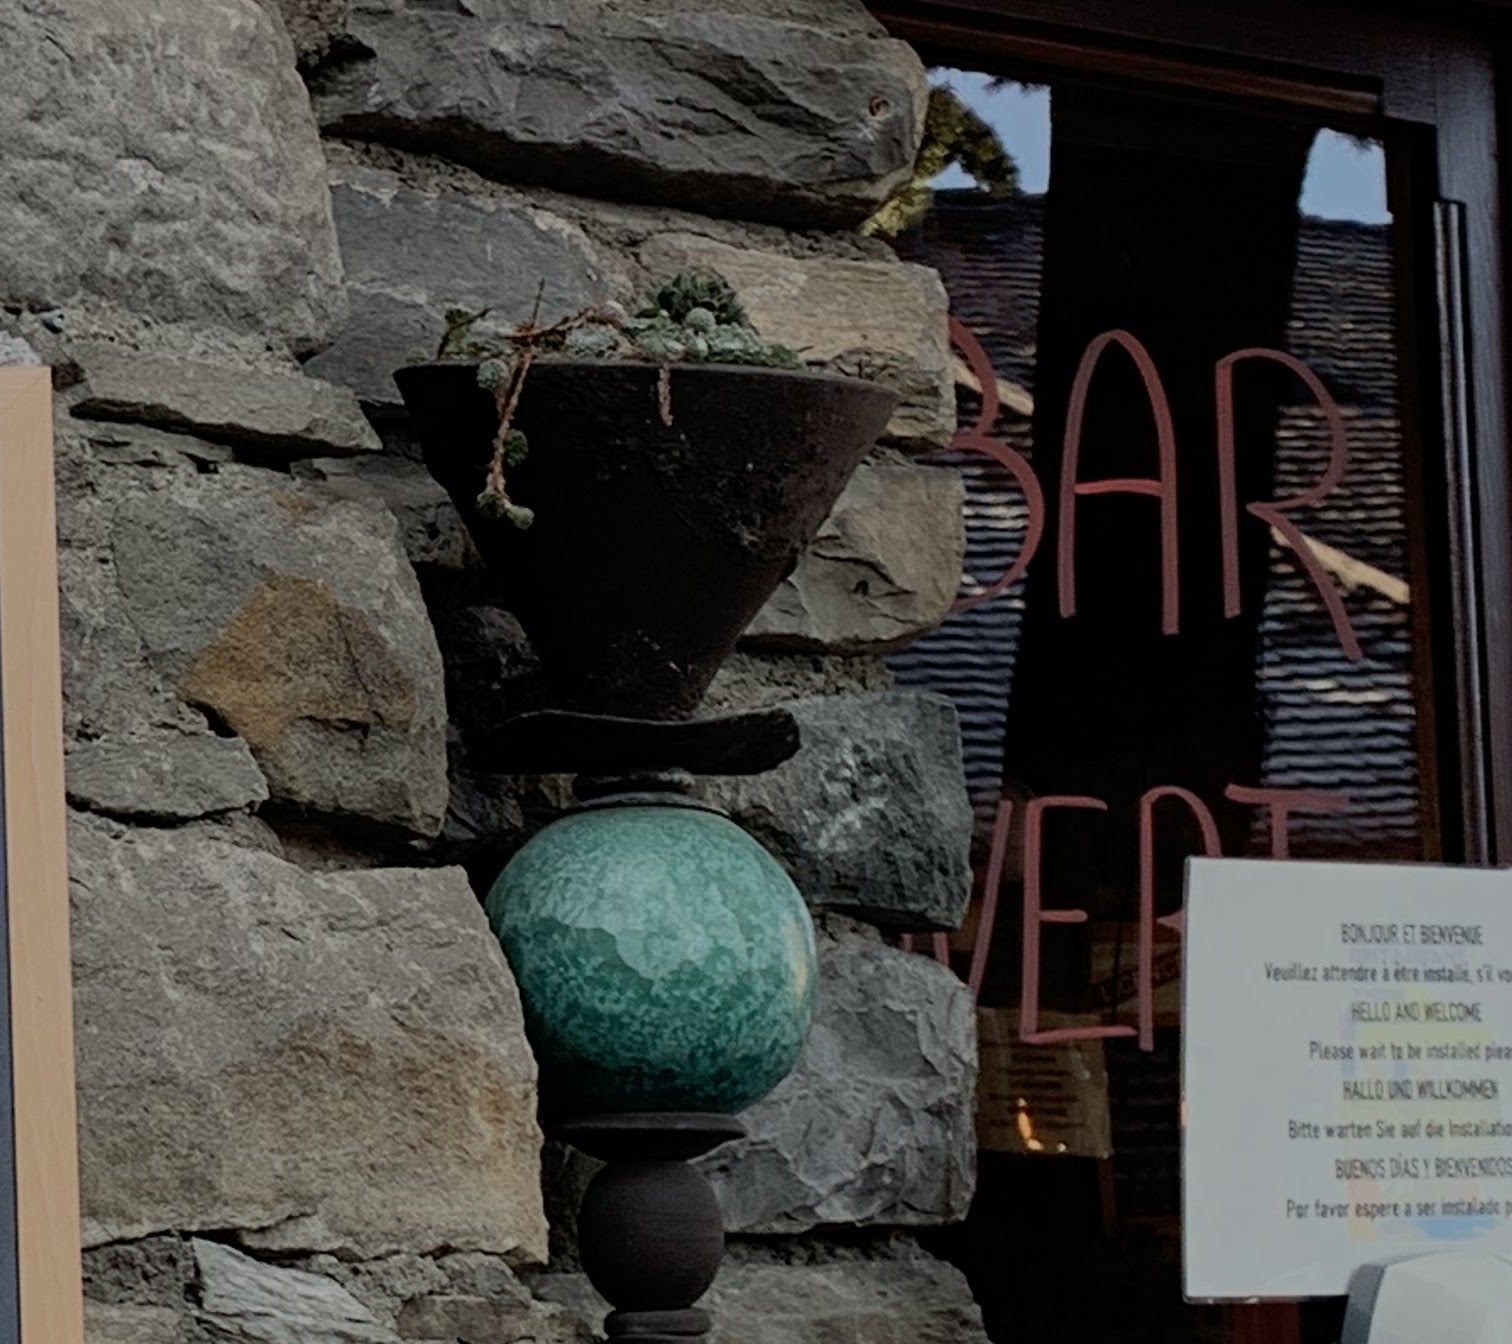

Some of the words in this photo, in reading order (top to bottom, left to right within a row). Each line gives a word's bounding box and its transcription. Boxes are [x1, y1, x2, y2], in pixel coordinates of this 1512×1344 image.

[946, 316, 1361, 659] BAR
[1341, 922, 1399, 945] BONJOUR
[1403, 922, 1416, 945] ET
[1420, 922, 1483, 945] BIENVENUE
[1264, 961, 1317, 983] Veuillez
[1323, 961, 1377, 983] attendre
[1351, 1001, 1391, 1023] HELLO
[1394, 1001, 1420, 1023] AND
[1423, 1001, 1483, 1023] WELCOME
[1309, 1041, 1354, 1061] Please
[1358, 1041, 1386, 1061] wait
[1390, 1041, 1403, 1061] to
[1407, 1041, 1421, 1061] be
[1426, 1041, 1480, 1061] installed
[1343, 1079, 1384, 1101] HALLO
[1388, 1079, 1413, 1101] UND
[1417, 1079, 1498, 1101] WILLKOMMEN
[1289, 1119, 1320, 1139] Bitte
[1326, 1119, 1372, 1139] warten
[1376, 1119, 1395, 1139] Sie
[1401, 1119, 1420, 1139] auf
[1335, 1158, 1385, 1179] BUENOS
[1389, 1153, 1419, 1178] DÍAS
[1422, 1158, 1430, 1179] Y
[1287, 1199, 1309, 1218] Por
[1314, 1199, 1350, 1218] favor
[1355, 1202, 1399, 1223] espere
[1404, 1203, 1412, 1217] a
[1416, 1202, 1436, 1217] ser
